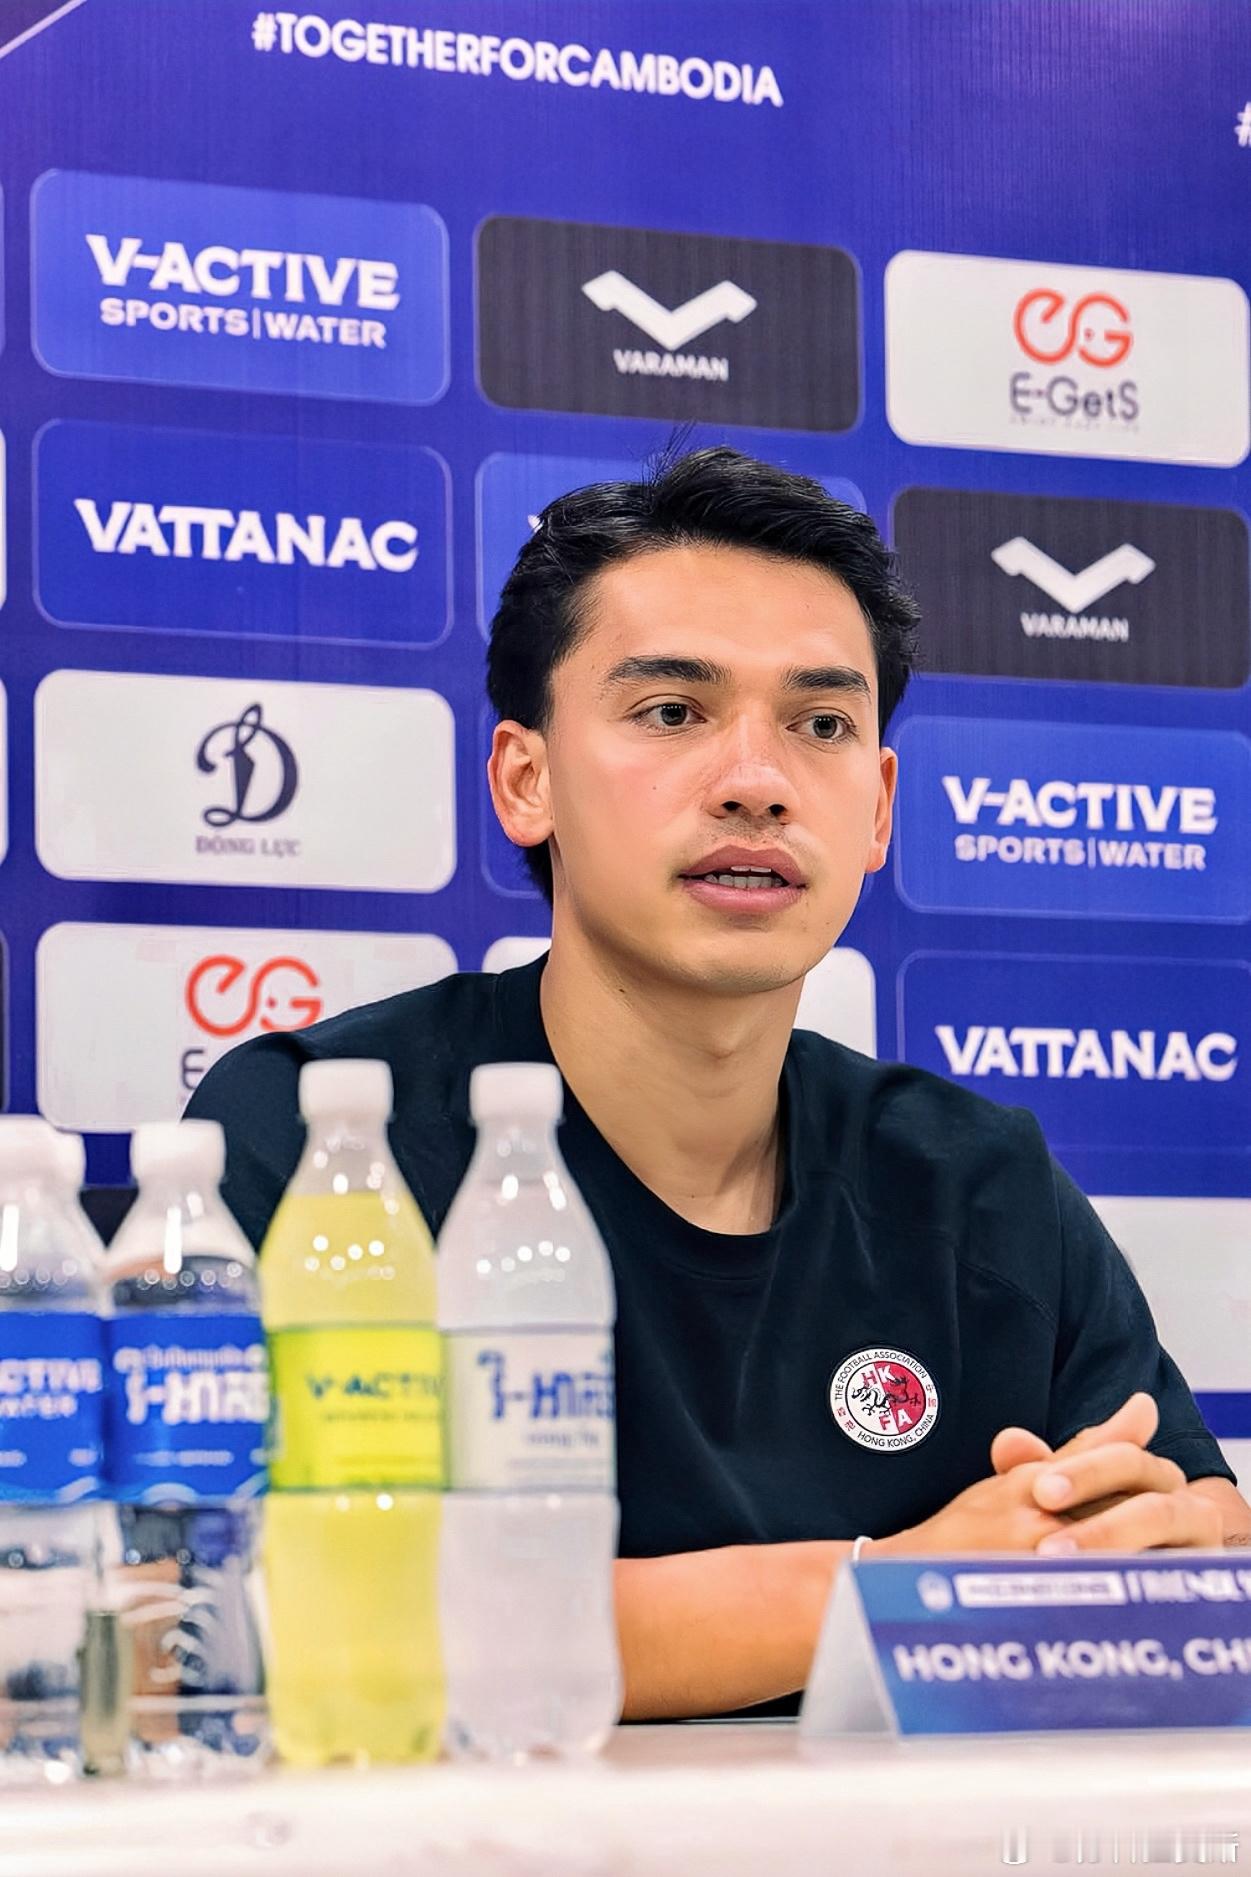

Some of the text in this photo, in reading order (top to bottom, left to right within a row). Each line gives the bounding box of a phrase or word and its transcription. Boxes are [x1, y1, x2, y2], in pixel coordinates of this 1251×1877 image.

[252, 12, 783, 107] #TOGETHERFORCAMBODIA
[86, 234, 400, 311] V-ACTIVE
[101, 297, 386, 348] SPORTS WATER
[613, 348, 729, 382] VARAMAN
[1009, 371, 1139, 420] E-GetS
[74, 498, 418, 572] VATTANAC
[1020, 613, 1129, 642] VARAMAN
[942, 775, 1218, 834] V-ACTIVE
[1098, 840, 1206, 870] WATER
[935, 1025, 1238, 1081] VATTANAC
[834, 1351, 928, 1401] THE FOOTBALL ASSOCIATION
[857, 1431, 886, 1447] HONG
[914, 1414, 935, 1437] CHINA
[893, 1643, 1034, 1683] HONG
[1035, 1640, 1183, 1680] KONG,
